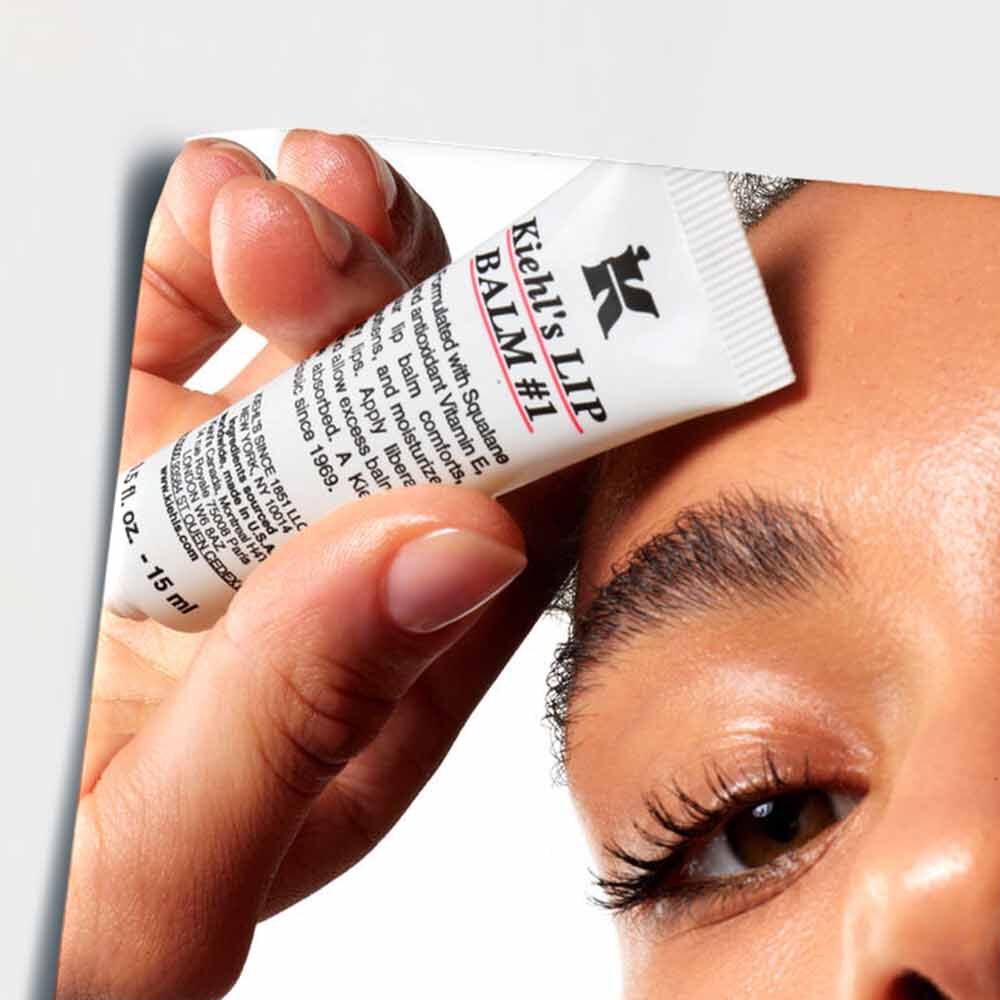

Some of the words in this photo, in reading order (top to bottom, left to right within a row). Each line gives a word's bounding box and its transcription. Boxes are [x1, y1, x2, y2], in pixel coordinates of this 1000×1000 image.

[390, 321, 405, 343] lip
[475, 247, 537, 369] BALM
[514, 378, 558, 422] #1
[512, 216, 566, 340] Kiehl's
[550, 348, 608, 423] LIP
[312, 362, 341, 442] absorbed.
[335, 452, 352, 467] A
[332, 354, 347, 392] allow
[349, 342, 364, 376] lips.
[359, 387, 387, 434] Apply
[377, 365, 400, 398] and
[397, 353, 421, 398] balm
[411, 307, 448, 394] antioxidant
[439, 392, 475, 456] Vitamin
[470, 455, 490, 476] E,
[448, 352, 470, 388] with
[462, 388, 510, 465] Squalane
[240, 405, 249, 431] NEW
[254, 476, 271, 495] NY
[265, 499, 293, 533] 10014
[294, 397, 315, 442] since
[310, 444, 339, 492] 1969.
[339, 396, 370, 456] excess
[419, 410, 465, 485] comforts,
[160, 466, 199, 562] www.kiehls.com
[176, 495, 190, 511] ST
[183, 450, 200, 503] LONDON
[194, 503, 209, 526] W6
[205, 527, 226, 552] 8AZ
[195, 457, 209, 498] Royale
[206, 499, 231, 537] 75008
[226, 537, 251, 565] Paris
[218, 495, 252, 543] Montreal
[223, 470, 242, 505] made
[238, 506, 250, 520] in
[224, 416, 247, 483] Ingredients
[243, 485, 278, 537] sourced
[254, 434, 276, 477] SINCE
[270, 478, 291, 507] 1851
[286, 508, 307, 531] LLC
[122, 510, 139, 544] oz.
[147, 566, 174, 592] 15
[165, 592, 200, 615] ml
